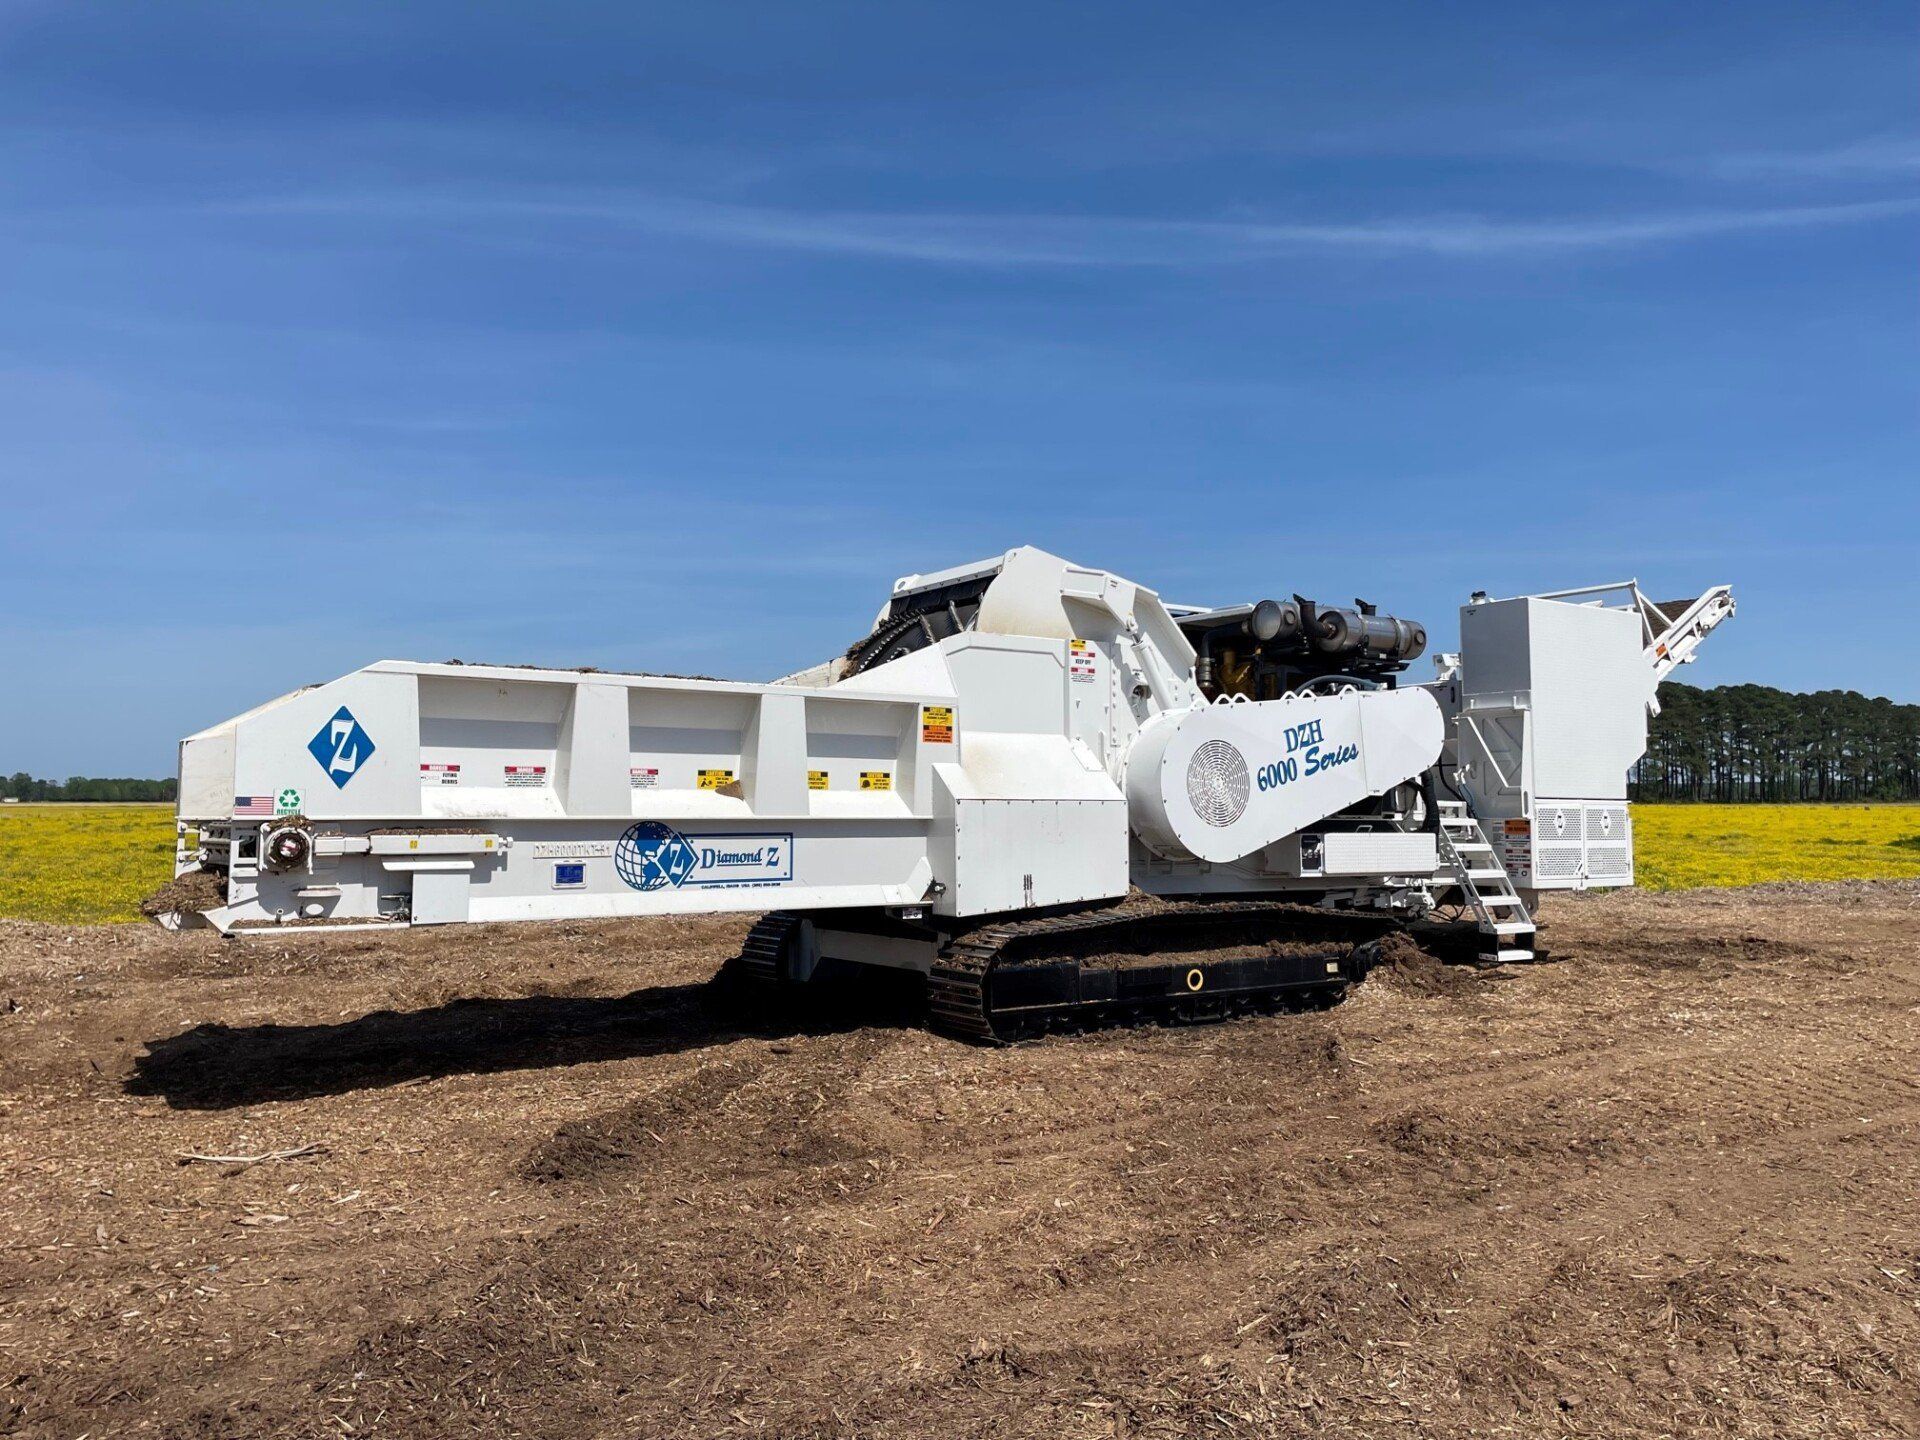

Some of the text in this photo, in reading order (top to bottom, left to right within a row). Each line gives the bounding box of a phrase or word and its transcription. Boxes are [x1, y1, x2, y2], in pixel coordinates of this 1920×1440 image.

[329, 719, 358, 775] Z
[1283, 719, 1324, 753] DZH
[1257, 743, 1359, 791] 6000 Series
[669, 843, 780, 875] Z Diamond Z
